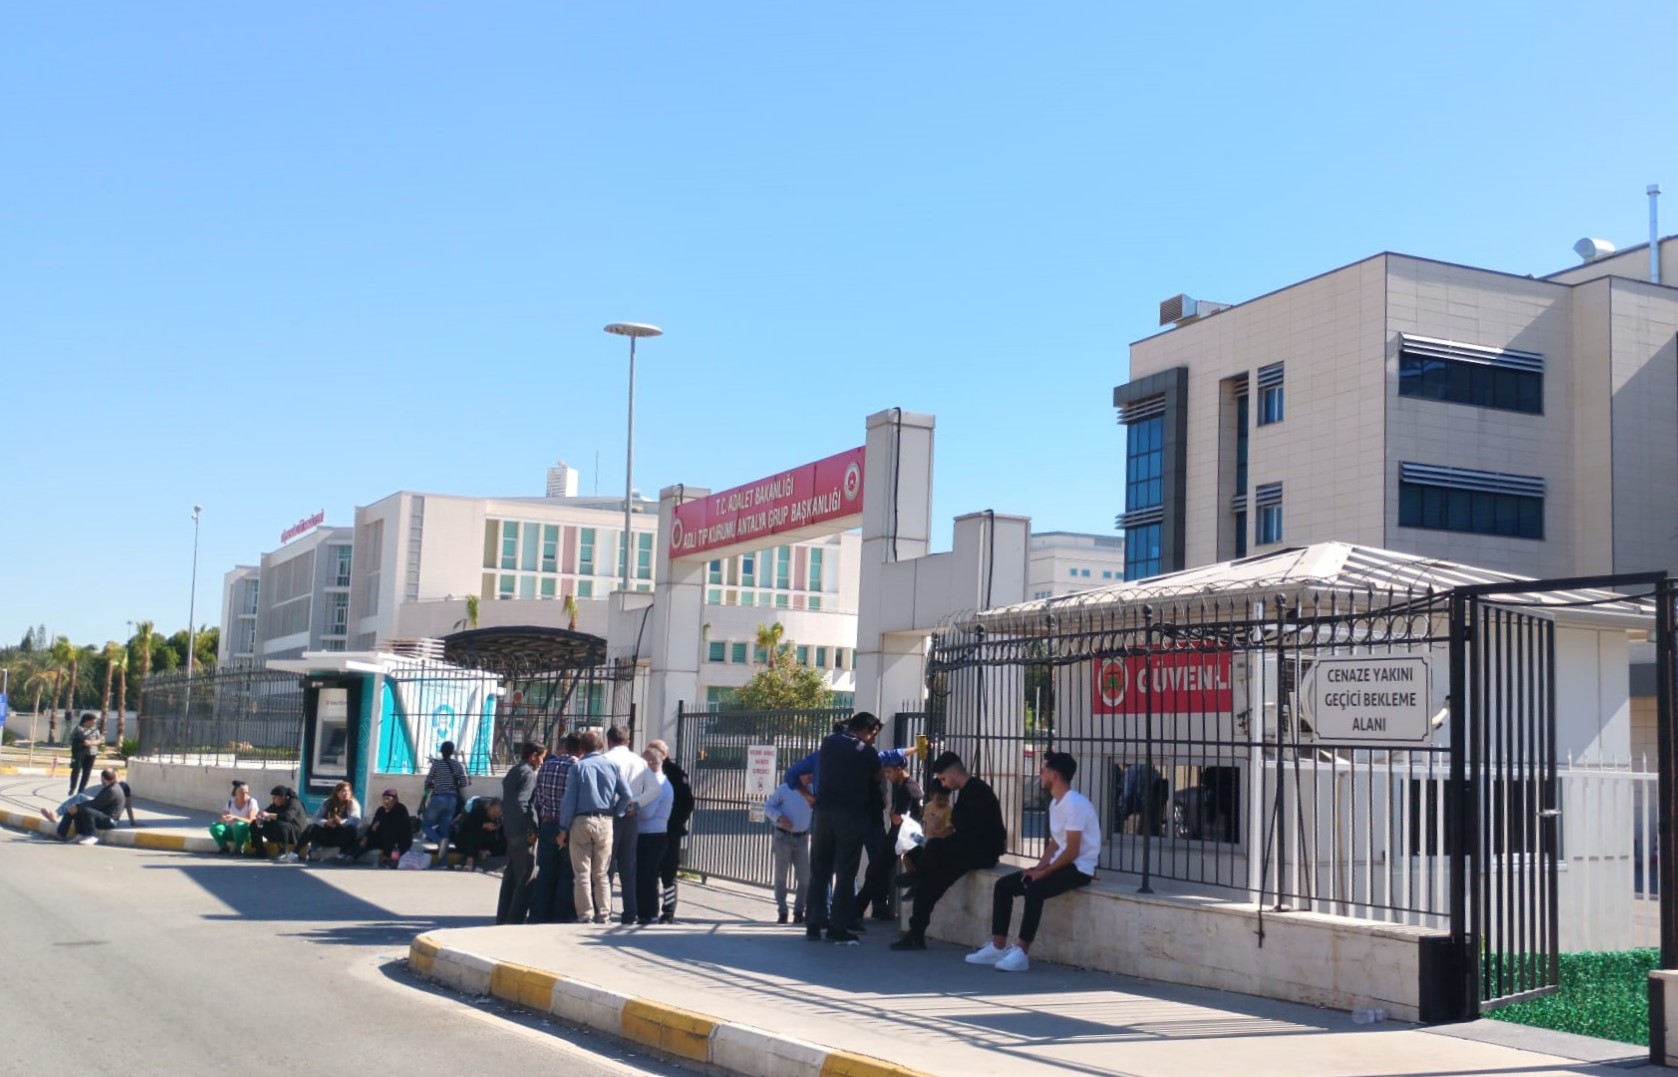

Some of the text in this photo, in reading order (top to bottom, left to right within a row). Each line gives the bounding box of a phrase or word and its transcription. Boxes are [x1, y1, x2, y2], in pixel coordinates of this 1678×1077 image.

[729, 489, 754, 511] ADALET
[755, 474, 794, 504] BAKANLIĞI
[709, 520, 736, 544] KURUMU
[738, 512, 767, 536] ANTALYA
[768, 506, 788, 528] GRUP
[791, 487, 842, 525] BAŞKANLIĞI
[1327, 667, 1413, 682] CENAZE YAKINI
[1325, 689, 1416, 710] GEÇİCİ BEKLEME
[1352, 717, 1386, 731] ALANI
